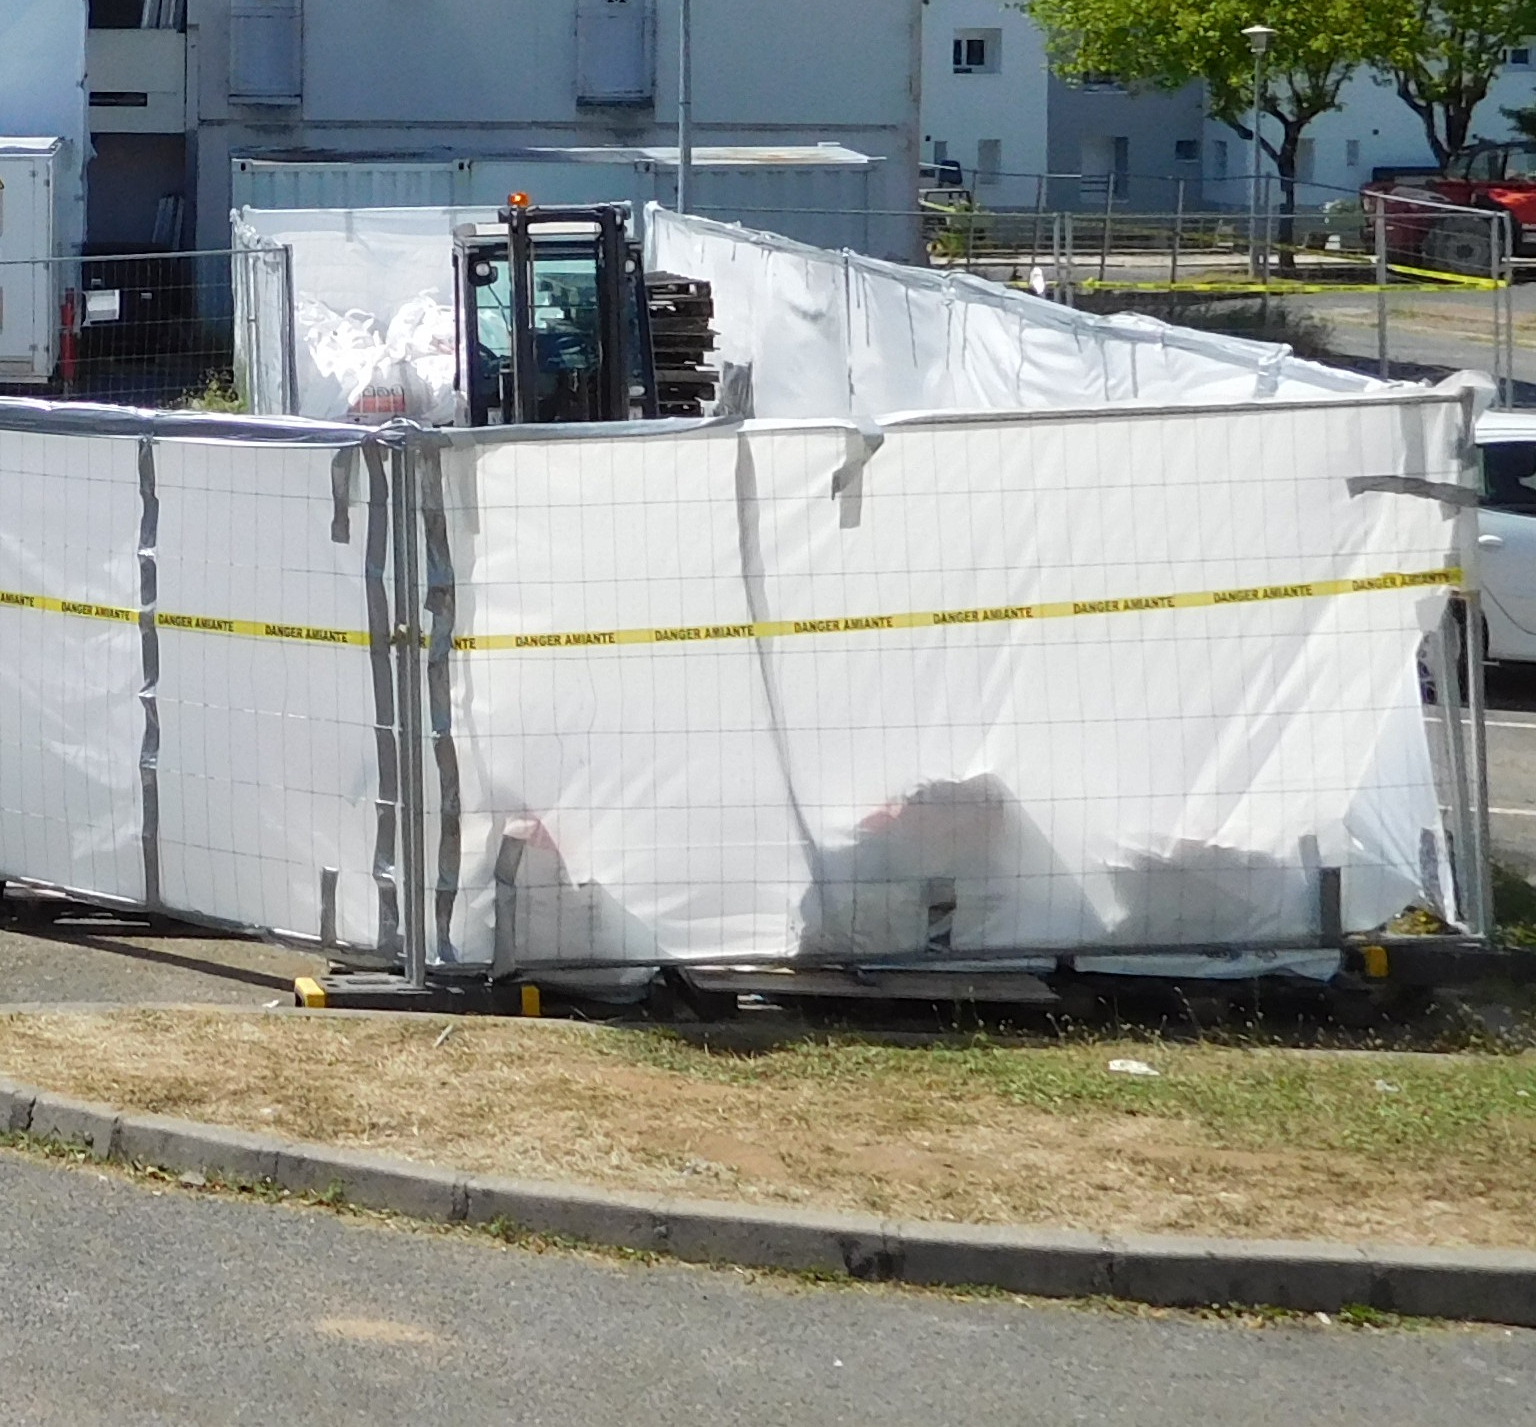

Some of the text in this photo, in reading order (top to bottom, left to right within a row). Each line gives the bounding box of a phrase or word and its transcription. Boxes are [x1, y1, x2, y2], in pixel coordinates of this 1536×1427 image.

[61, 601, 93, 616] DANGER
[157, 613, 193, 628] DANGER
[265, 624, 303, 638] DANGER
[515, 634, 561, 647] DANGER
[564, 632, 615, 646] AMIANTE
[654, 628, 701, 642] DANGER
[704, 625, 755, 639] AMIANTE
[794, 620, 840, 634] DANGER
[843, 616, 893, 631] AMIANTE
[933, 610, 978, 624] DANGER
[982, 606, 1034, 621] AMIANTE
[1073, 600, 1119, 615] DANGER
[1122, 595, 1175, 610] AMIANTE
[1213, 589, 1259, 604] DANGER
[1262, 584, 1314, 600] AMIANTE
[1352, 575, 1396, 591] DANGER
